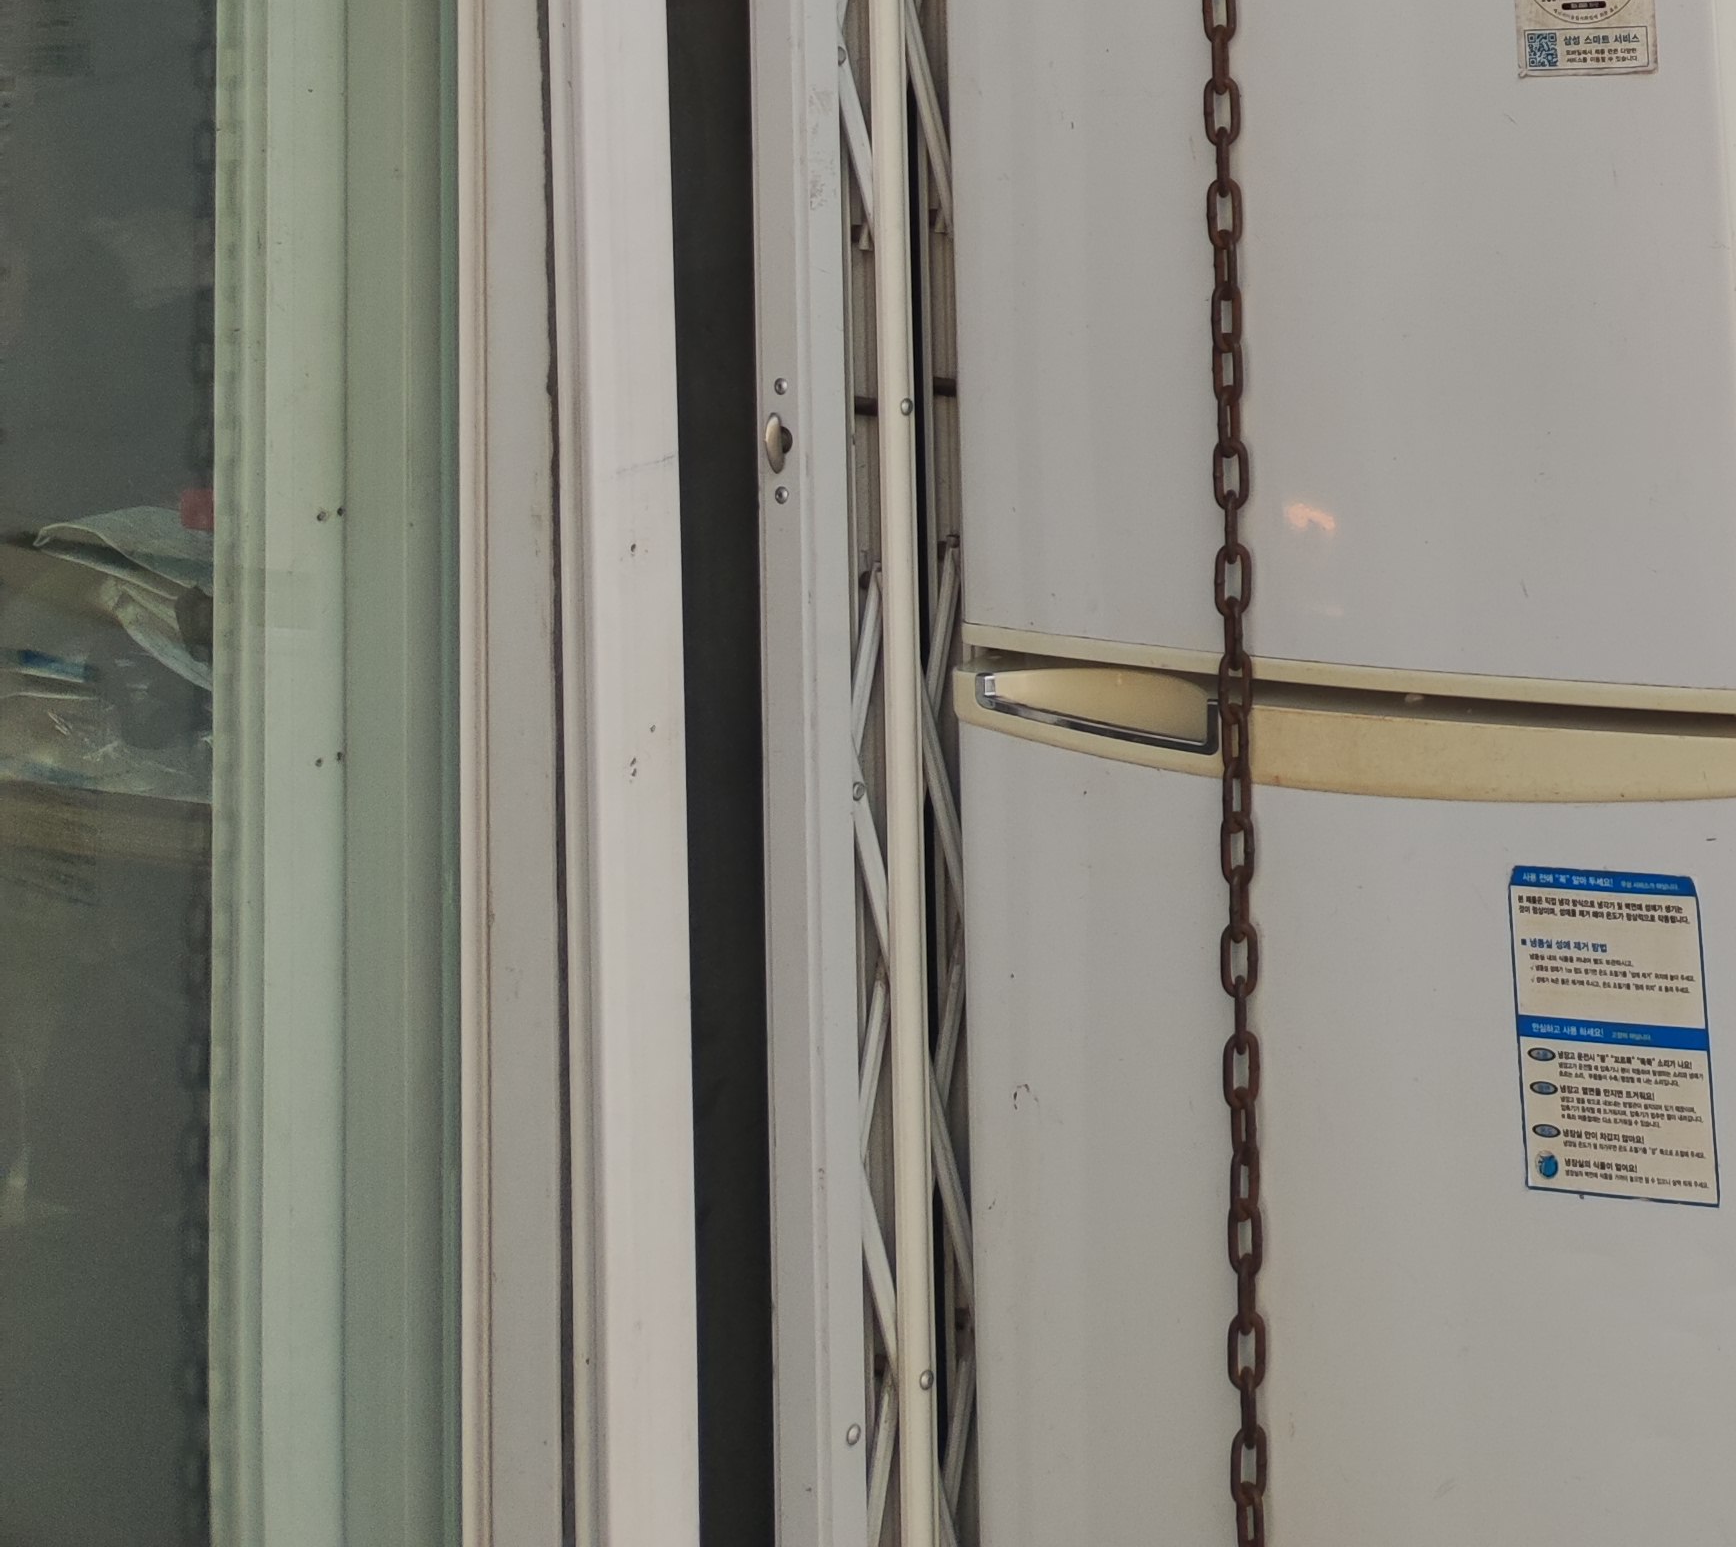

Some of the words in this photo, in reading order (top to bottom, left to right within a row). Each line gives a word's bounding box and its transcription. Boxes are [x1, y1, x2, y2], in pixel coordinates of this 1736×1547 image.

[1563, 35, 1580, 46] 삼성
[1584, 34, 1610, 45] 스마트
[1613, 33, 1640, 44] 서비스
